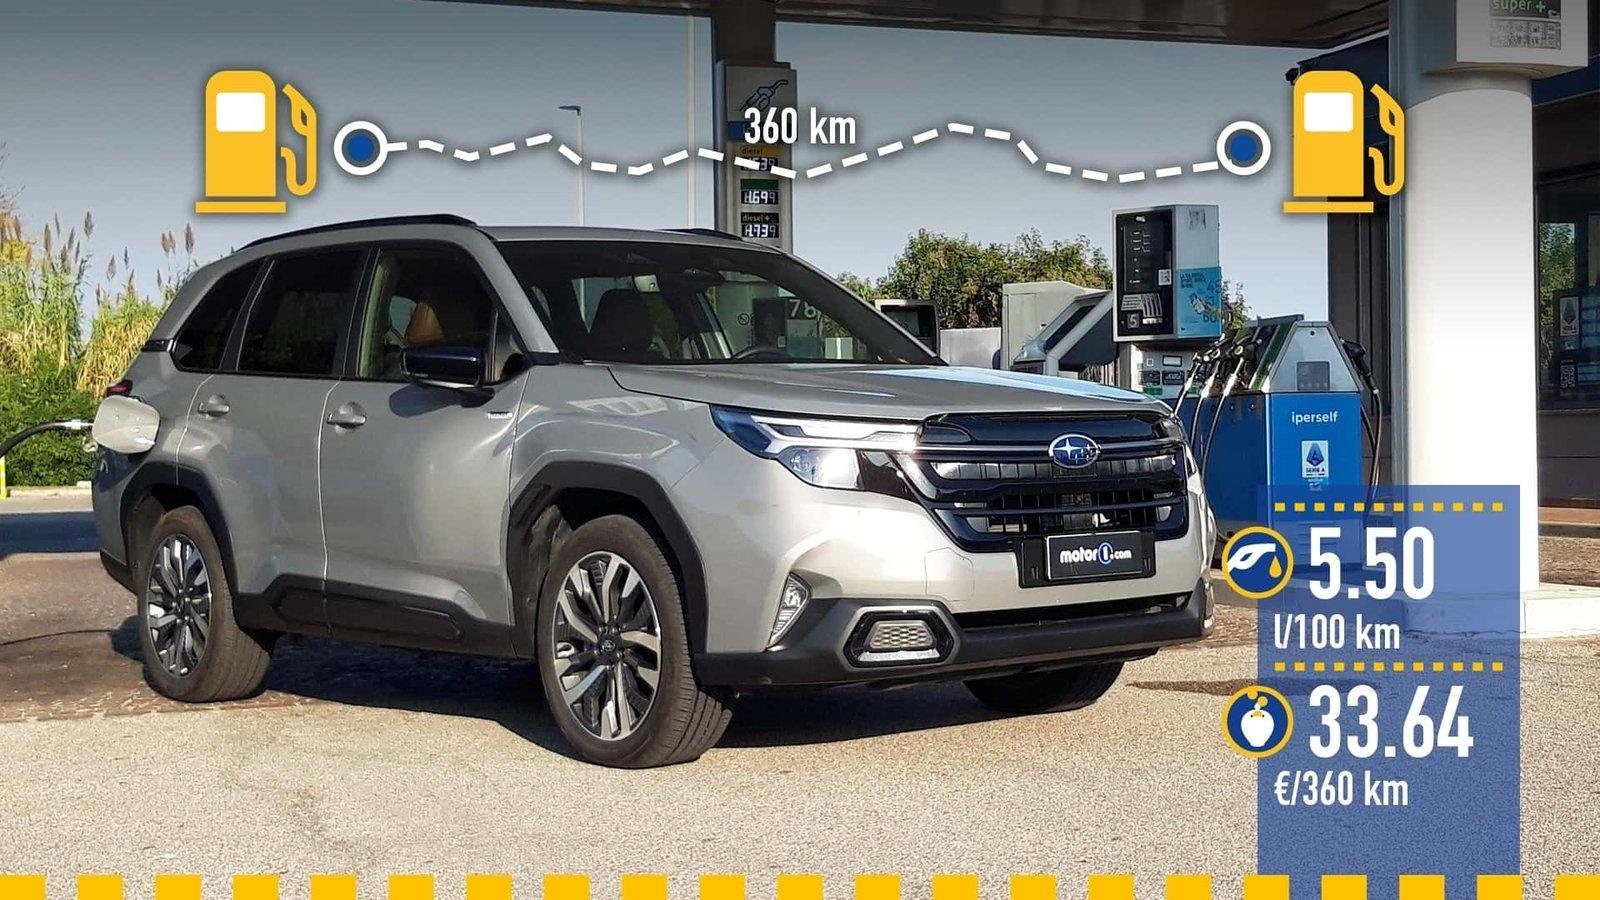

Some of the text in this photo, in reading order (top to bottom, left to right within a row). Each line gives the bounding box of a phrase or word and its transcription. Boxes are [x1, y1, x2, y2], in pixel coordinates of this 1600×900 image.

[1491, 0, 1532, 12] super
[741, 146, 763, 155] diesel
[1291, 411, 1338, 425] iperself
[1060, 543, 1132, 564] motor1.com
